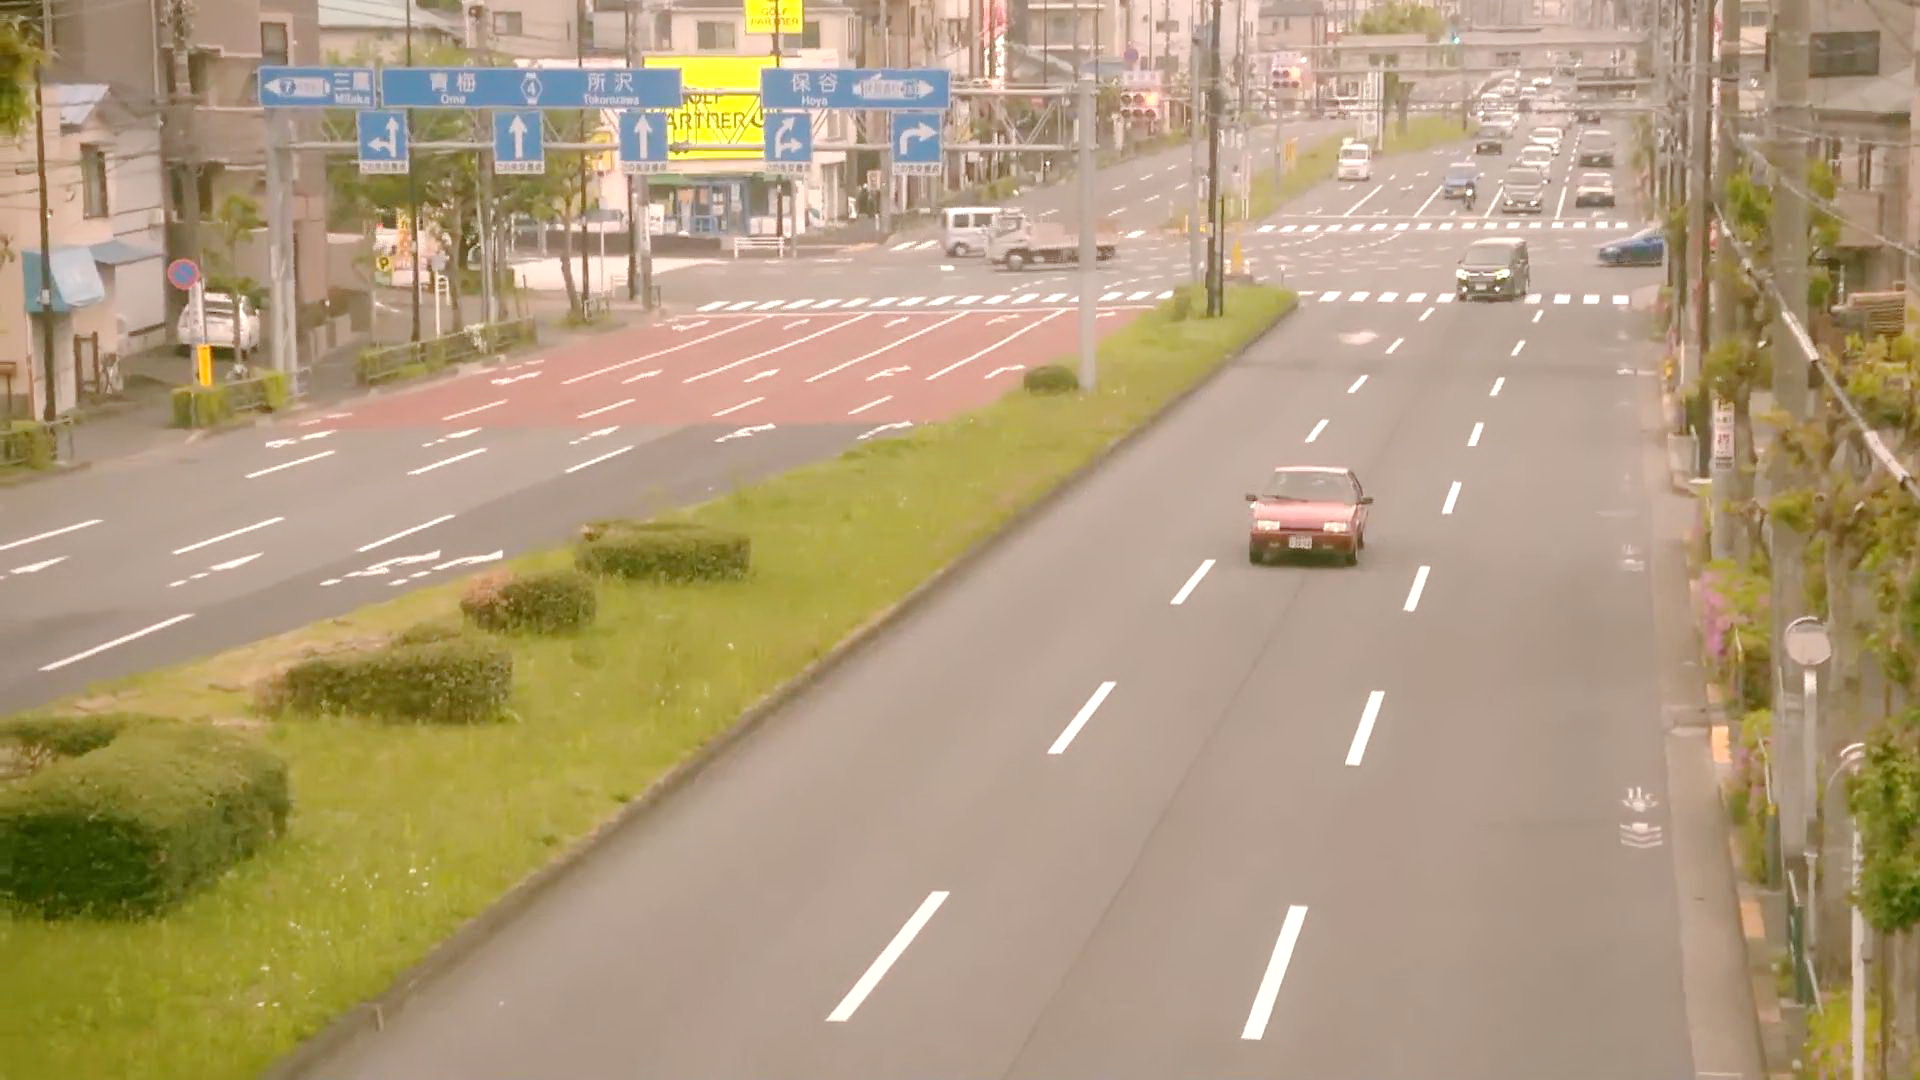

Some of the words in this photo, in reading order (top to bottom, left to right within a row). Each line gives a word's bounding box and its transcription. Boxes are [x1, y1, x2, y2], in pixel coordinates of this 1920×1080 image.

[750, 17, 799, 25] PARNER
[527, 81, 537, 96] 4
[586, 72, 635, 92] 所沢
[791, 72, 838, 93] 保谷
[440, 94, 466, 105] Ome
[801, 95, 828, 107] Hoya
[666, 112, 747, 130] ARTNER
